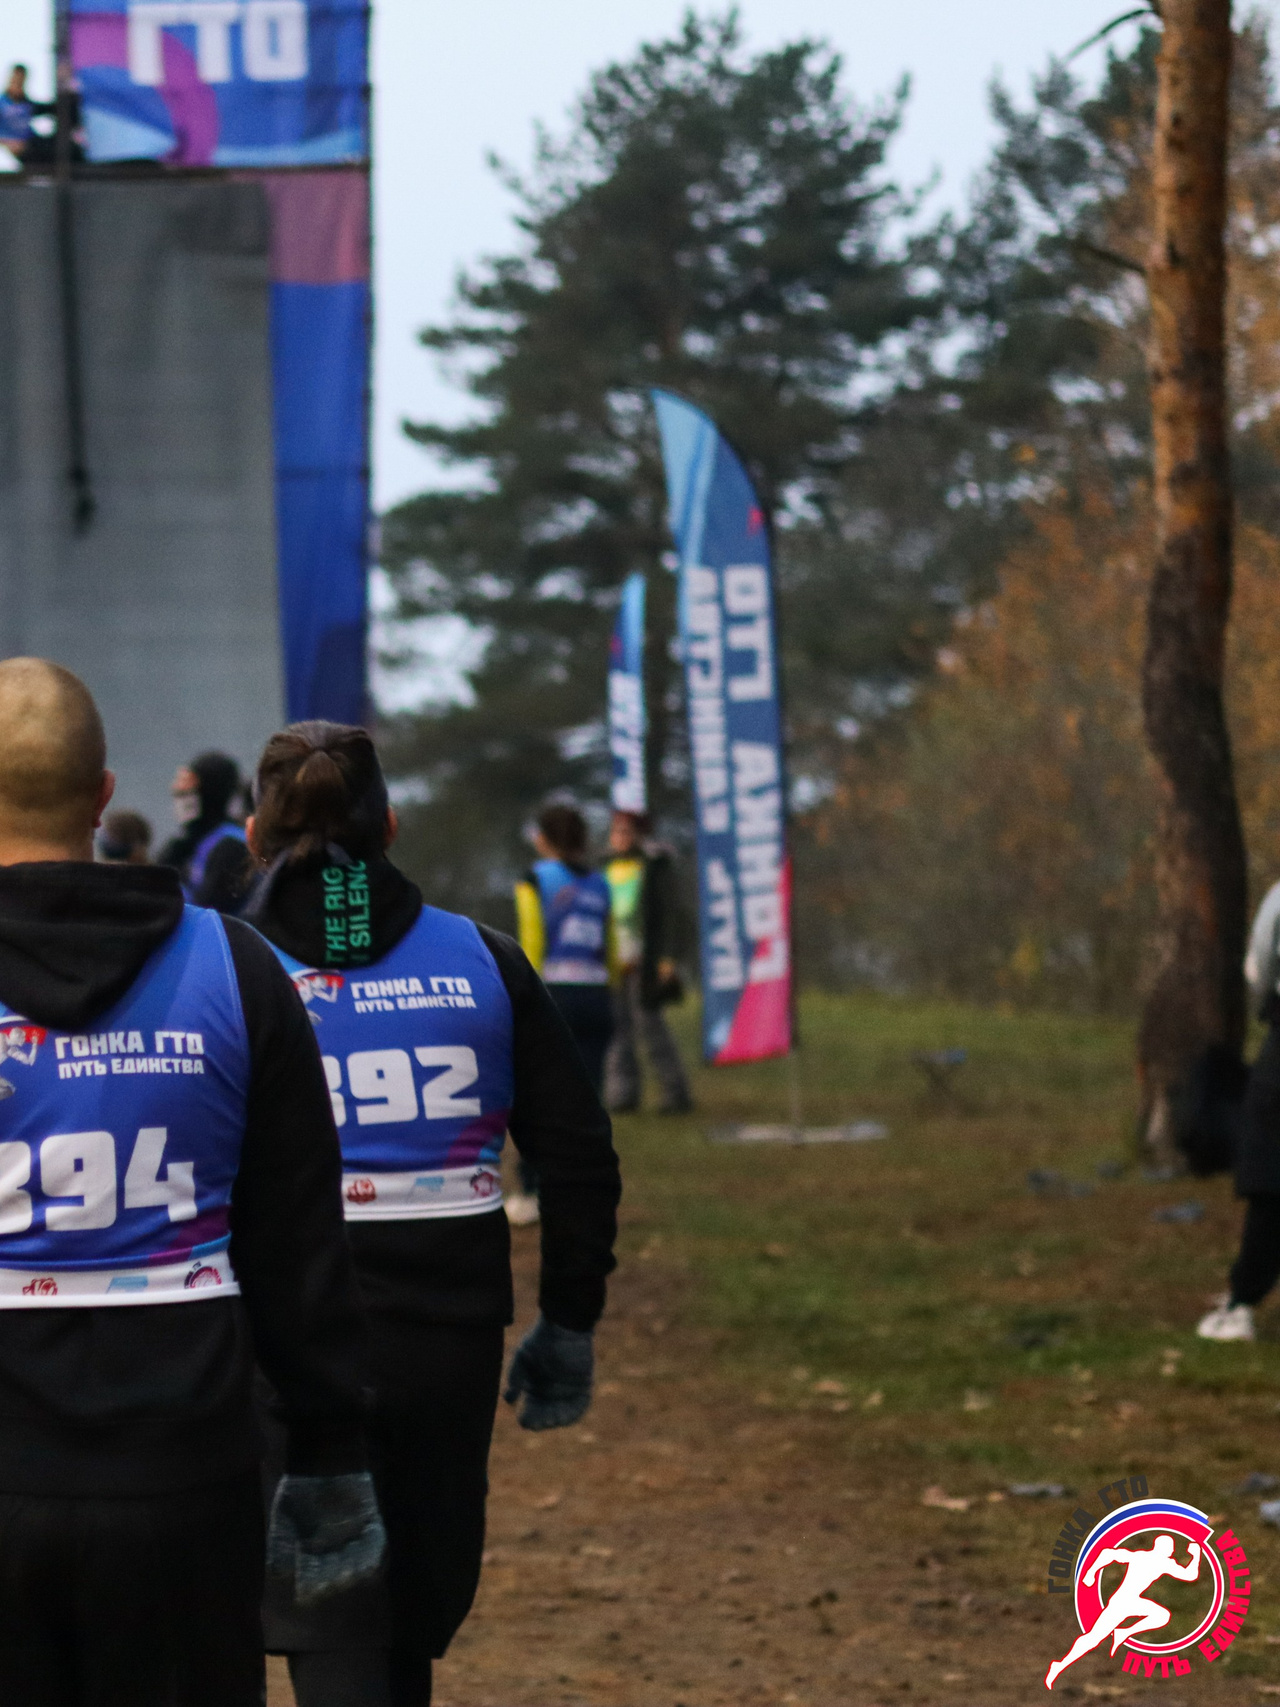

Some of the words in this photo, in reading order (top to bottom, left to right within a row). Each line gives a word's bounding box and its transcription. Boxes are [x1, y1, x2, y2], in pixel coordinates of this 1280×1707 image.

[128, 1, 308, 86] ГТО
[322, 867, 345, 910] RIG
[347, 860, 372, 947] SILENC
[325, 917, 347, 963] THE
[351, 978, 423, 1000] ГОНКА
[430, 976, 472, 995] ГТО
[355, 999, 395, 1014] ПУТЬ
[398, 995, 476, 1011] ЕДИНСТВА
[55, 1032, 146, 1060] ГОНКА
[155, 1031, 205, 1055] ГТО
[59, 1060, 108, 1080] ПУТЬ
[111, 1058, 205, 1076] ЕДИНСТВА
